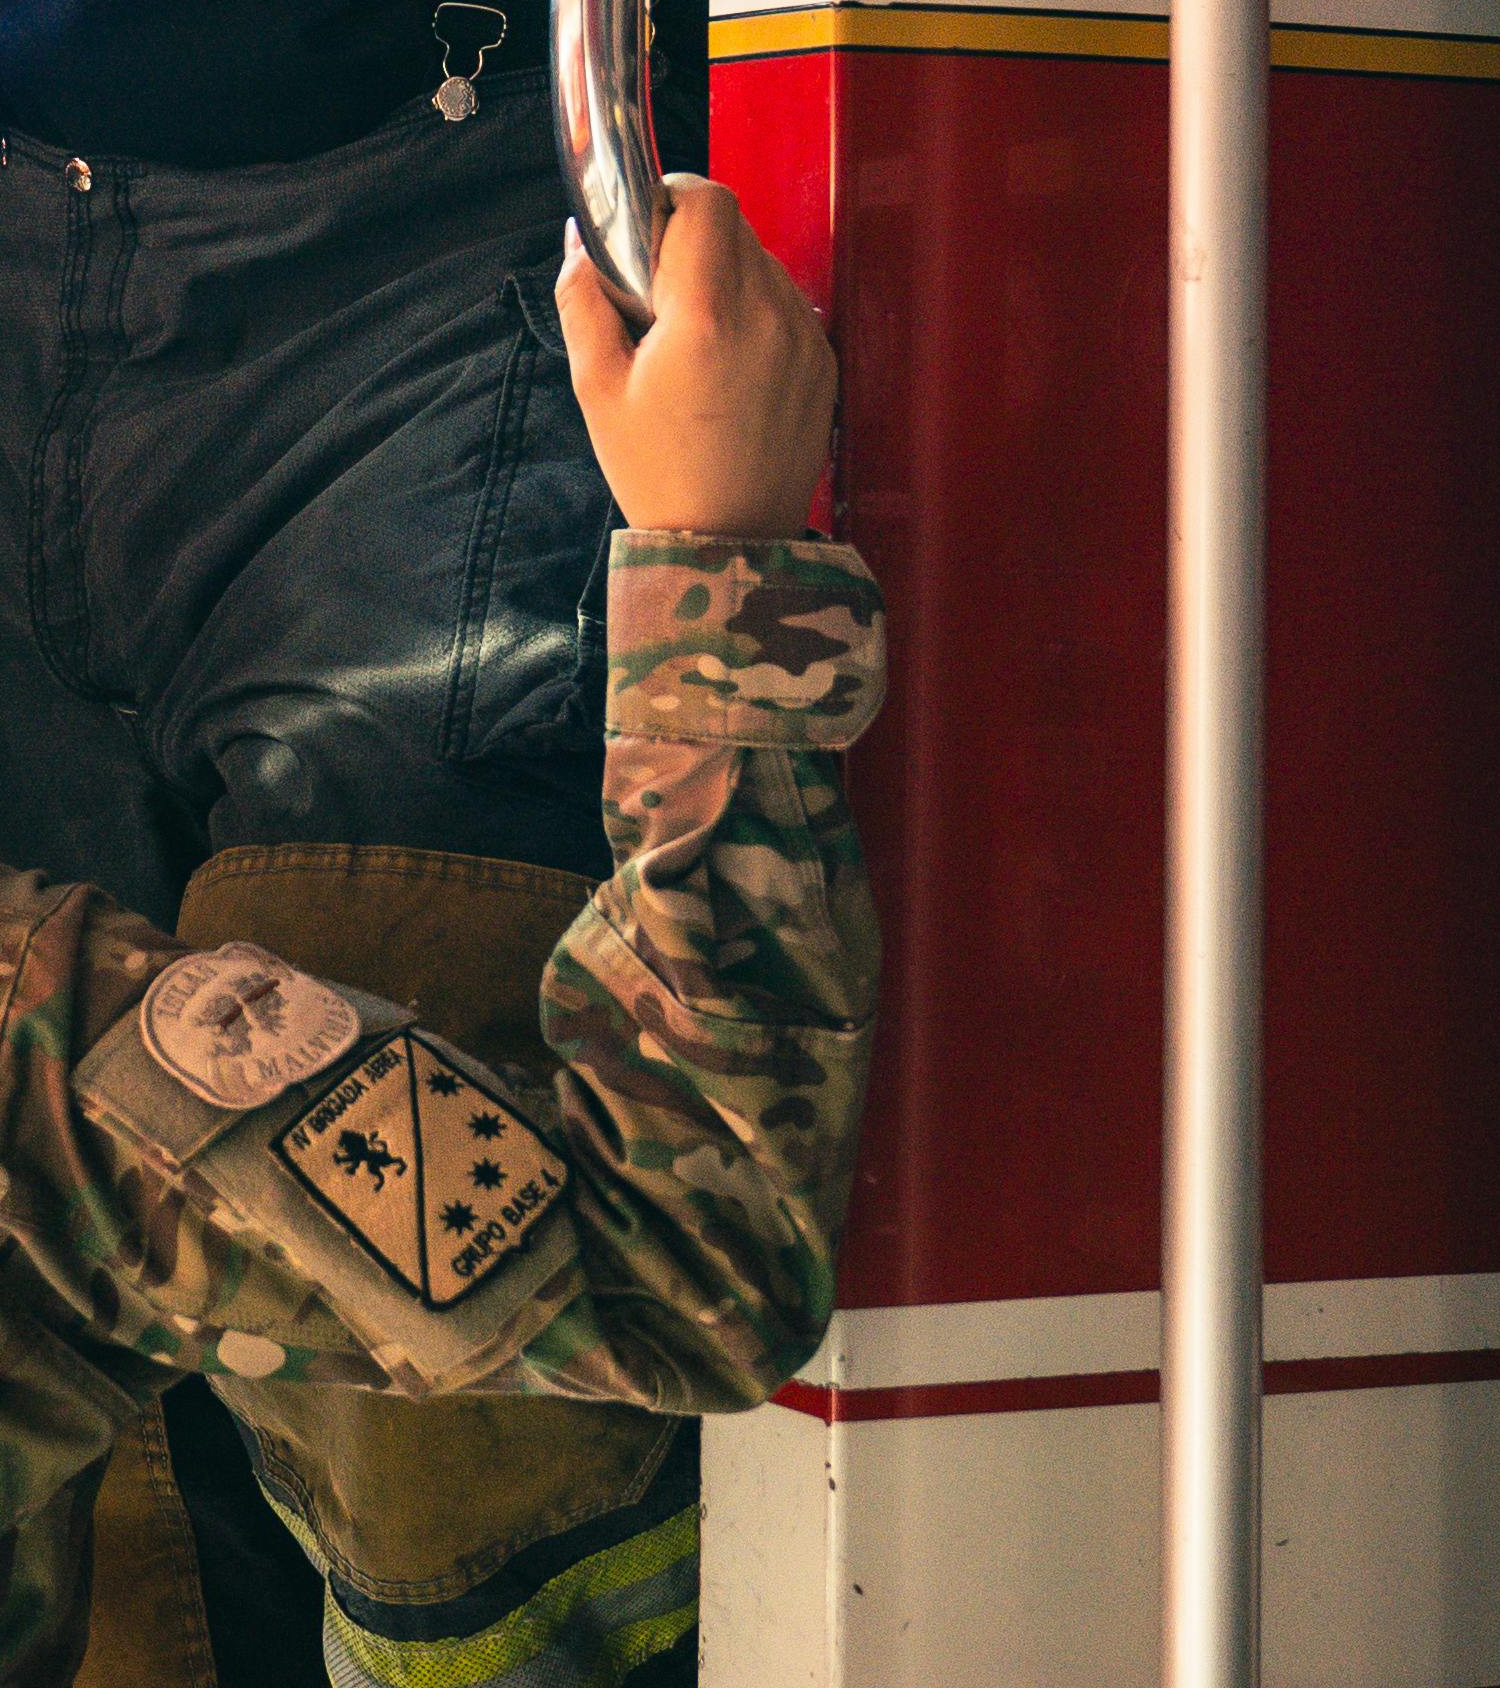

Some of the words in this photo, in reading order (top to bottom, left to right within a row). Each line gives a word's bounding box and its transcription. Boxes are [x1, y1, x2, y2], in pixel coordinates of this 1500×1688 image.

[307, 1077, 370, 1134] BRIGADA
[450, 1219, 506, 1277] GRUPO
[501, 1179, 547, 1227] BASE
